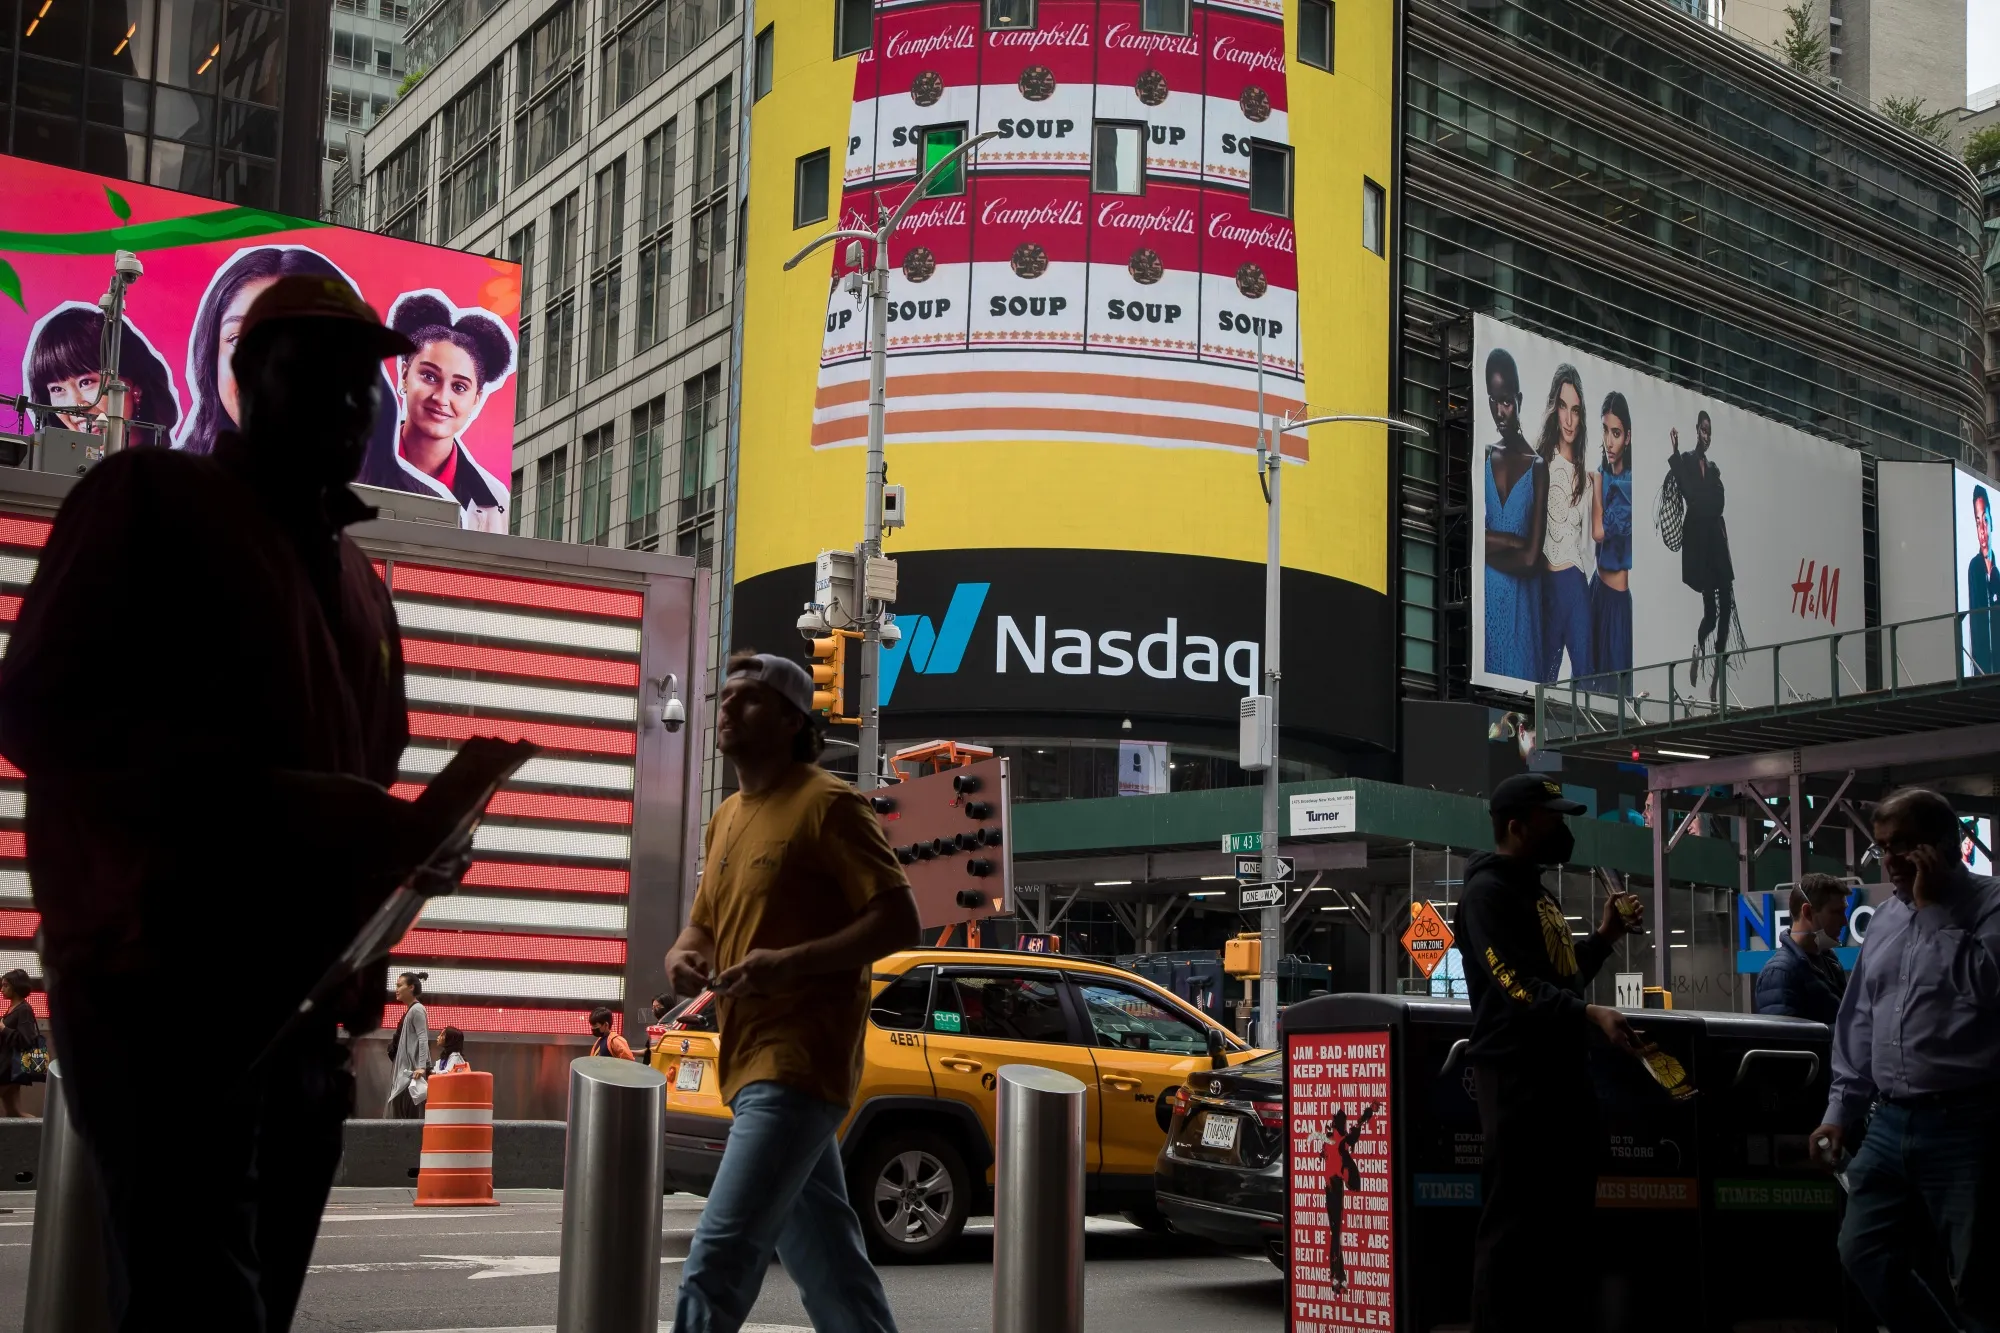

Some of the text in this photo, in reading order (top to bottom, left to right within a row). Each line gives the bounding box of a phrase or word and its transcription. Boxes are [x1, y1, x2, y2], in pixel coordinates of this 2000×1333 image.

[998, 118, 1074, 139] SOUP
[887, 298, 951, 322] SOUP
[990, 296, 1066, 317] SOUP
[1107, 299, 1182, 323] SOUP
[1218, 310, 1283, 338] SOUP
[1791, 558, 1840, 627] H&M
[996, 616, 1259, 697] Nasdaq
[1306, 810, 1339, 822] Turner
[1232, 837, 1240, 850] W
[1243, 836, 1252, 849] 43
[1244, 863, 1260, 872] ONE
[1246, 890, 1278, 901] ONE WAY
[1413, 940, 1443, 949] WORK ZONE
[934, 1013, 960, 1022] curb
[890, 1033, 919, 1047] 4E81
[1293, 1044, 1386, 1060] JAM BAD MONEY
[1293, 1063, 1386, 1078] KEEP THE FAITH
[1293, 1084, 1312, 1097] BILLIE
[1314, 1084, 1331, 1097] JEAN
[1342, 1084, 1358, 1097] WANT
[1359, 1084, 1370, 1097] YOU
[1372, 1083, 1386, 1097] BACK
[1134, 1094, 1154, 1103] NYC
[1294, 1102, 1318, 1115] BLAME
[1321, 1102, 1327, 1115] IT
[1344, 1102, 1357, 1115] THE
[1294, 1120, 1315, 1133] CAN
[1377, 1120, 1387, 1134] IT
[1454, 1133, 1485, 1142] EXPLOR
[1610, 1135, 1634, 1144] GO TO
[1354, 1140, 1376, 1154] ABOUT
[1379, 1141, 1388, 1155] US
[1454, 1144, 1478, 1152] MOST
[1610, 1147, 1655, 1158] TSQ.ORG
[1295, 1175, 1315, 1189] MAN
[1360, 1178, 1388, 1192] IRROR
[1418, 1182, 1475, 1199] TIMES
[1629, 1182, 1687, 1200] SQUARE
[1295, 1193, 1312, 1207] DON'T
[1353, 1196, 1364, 1210] GET
[1365, 1196, 1388, 1212] ENOUGH
[1718, 1187, 1834, 1204] TIMES SQUARE
[1295, 1211, 1315, 1225] SMOOTH
[1347, 1214, 1363, 1228] BLACK
[1364, 1215, 1372, 1229] OR
[1373, 1216, 1389, 1230] WHITE
[1295, 1229, 1310, 1243] I'LL
[1315, 1230, 1326, 1244] BE
[1368, 1234, 1389, 1250] ABC
[1295, 1247, 1314, 1262] BEAT
[1317, 1249, 1324, 1263] IT
[1361, 1252, 1390, 1268] NATURE
[1354, 1271, 1390, 1288] MOSCOW
[1352, 1289, 1364, 1304] LOVE
[1366, 1291, 1376, 1306] YOU
[1377, 1292, 1390, 1307] SAVE
[1296, 1302, 1390, 1326] THRILLER
[1296, 1321, 1317, 1333] WANNA
